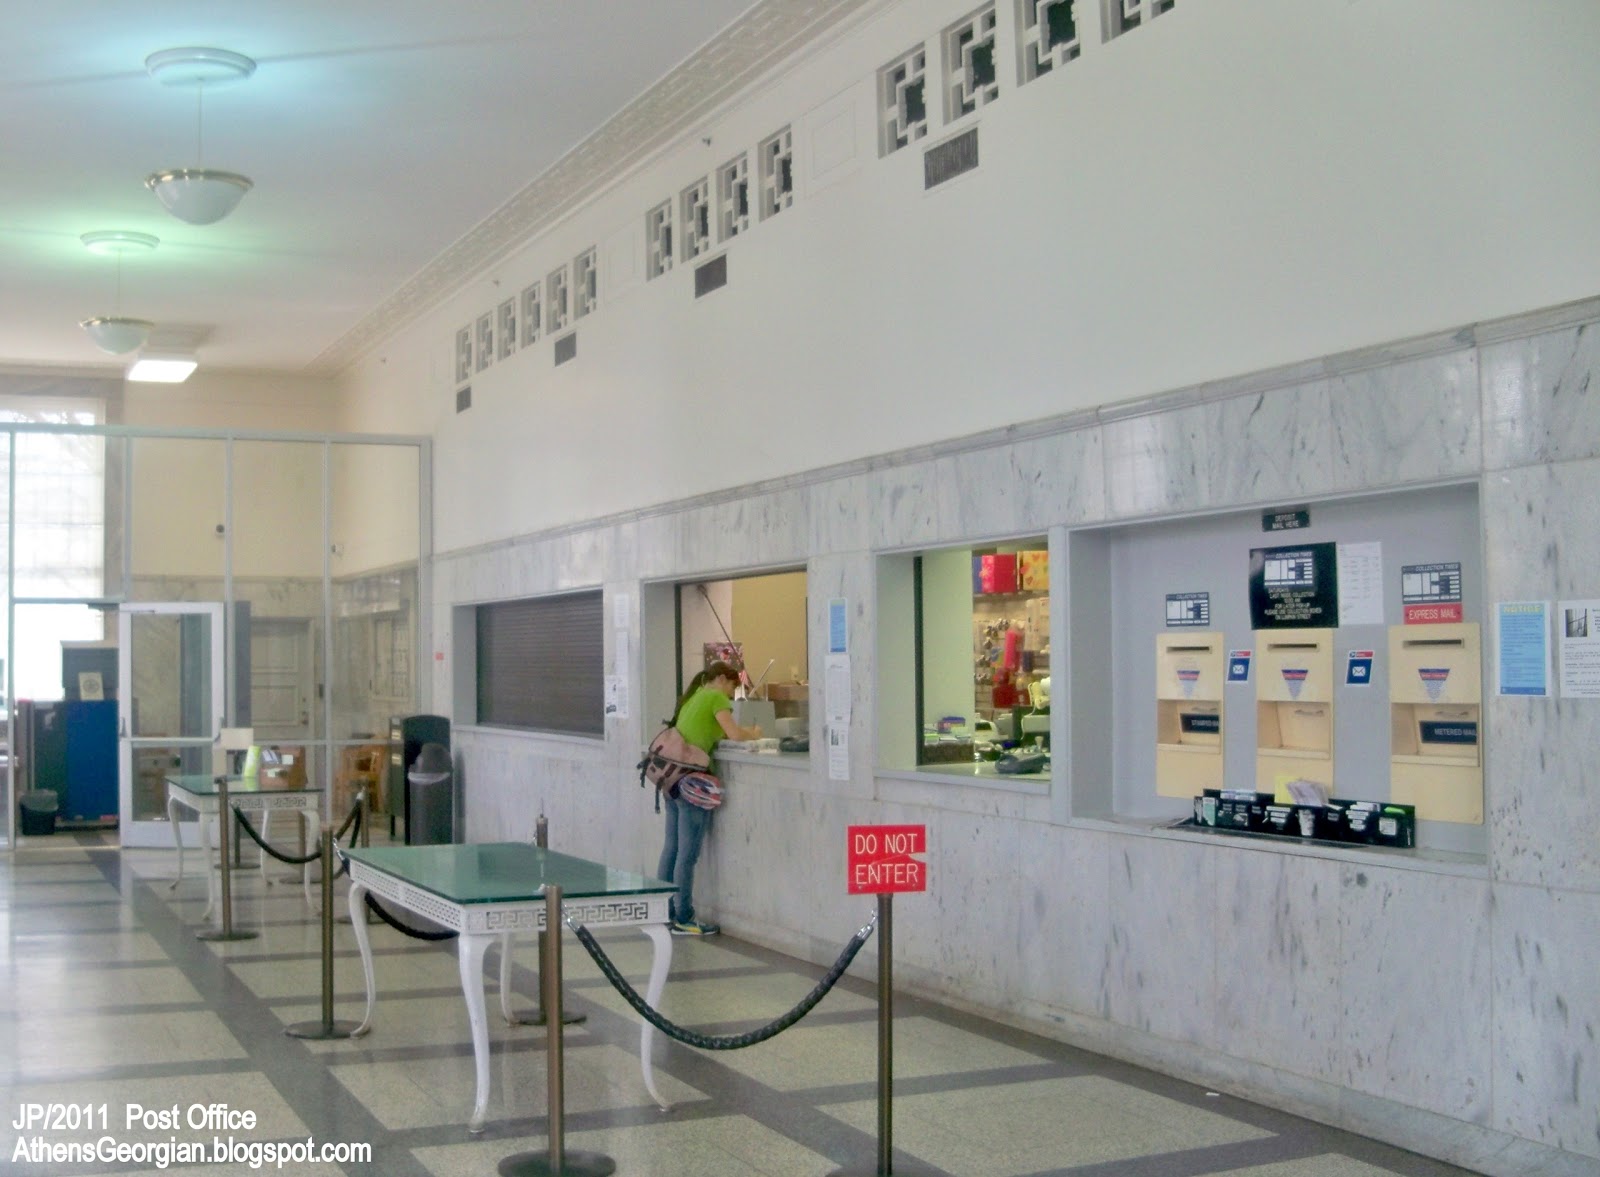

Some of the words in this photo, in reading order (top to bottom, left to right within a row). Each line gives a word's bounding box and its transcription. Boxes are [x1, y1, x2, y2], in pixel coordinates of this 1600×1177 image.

[1275, 513, 1295, 522] DEPOSIT
[1286, 520, 1299, 528] HERE
[1415, 564, 1444, 572] COLLECTION
[1409, 609, 1438, 620] EXPRESS
[1440, 608, 1457, 618] MAIL
[1503, 605, 1541, 614] NOTICE
[1434, 728, 1463, 736] METERED
[855, 834, 877, 854] DO
[885, 833, 917, 854] NOT
[856, 863, 919, 885] ENTER
